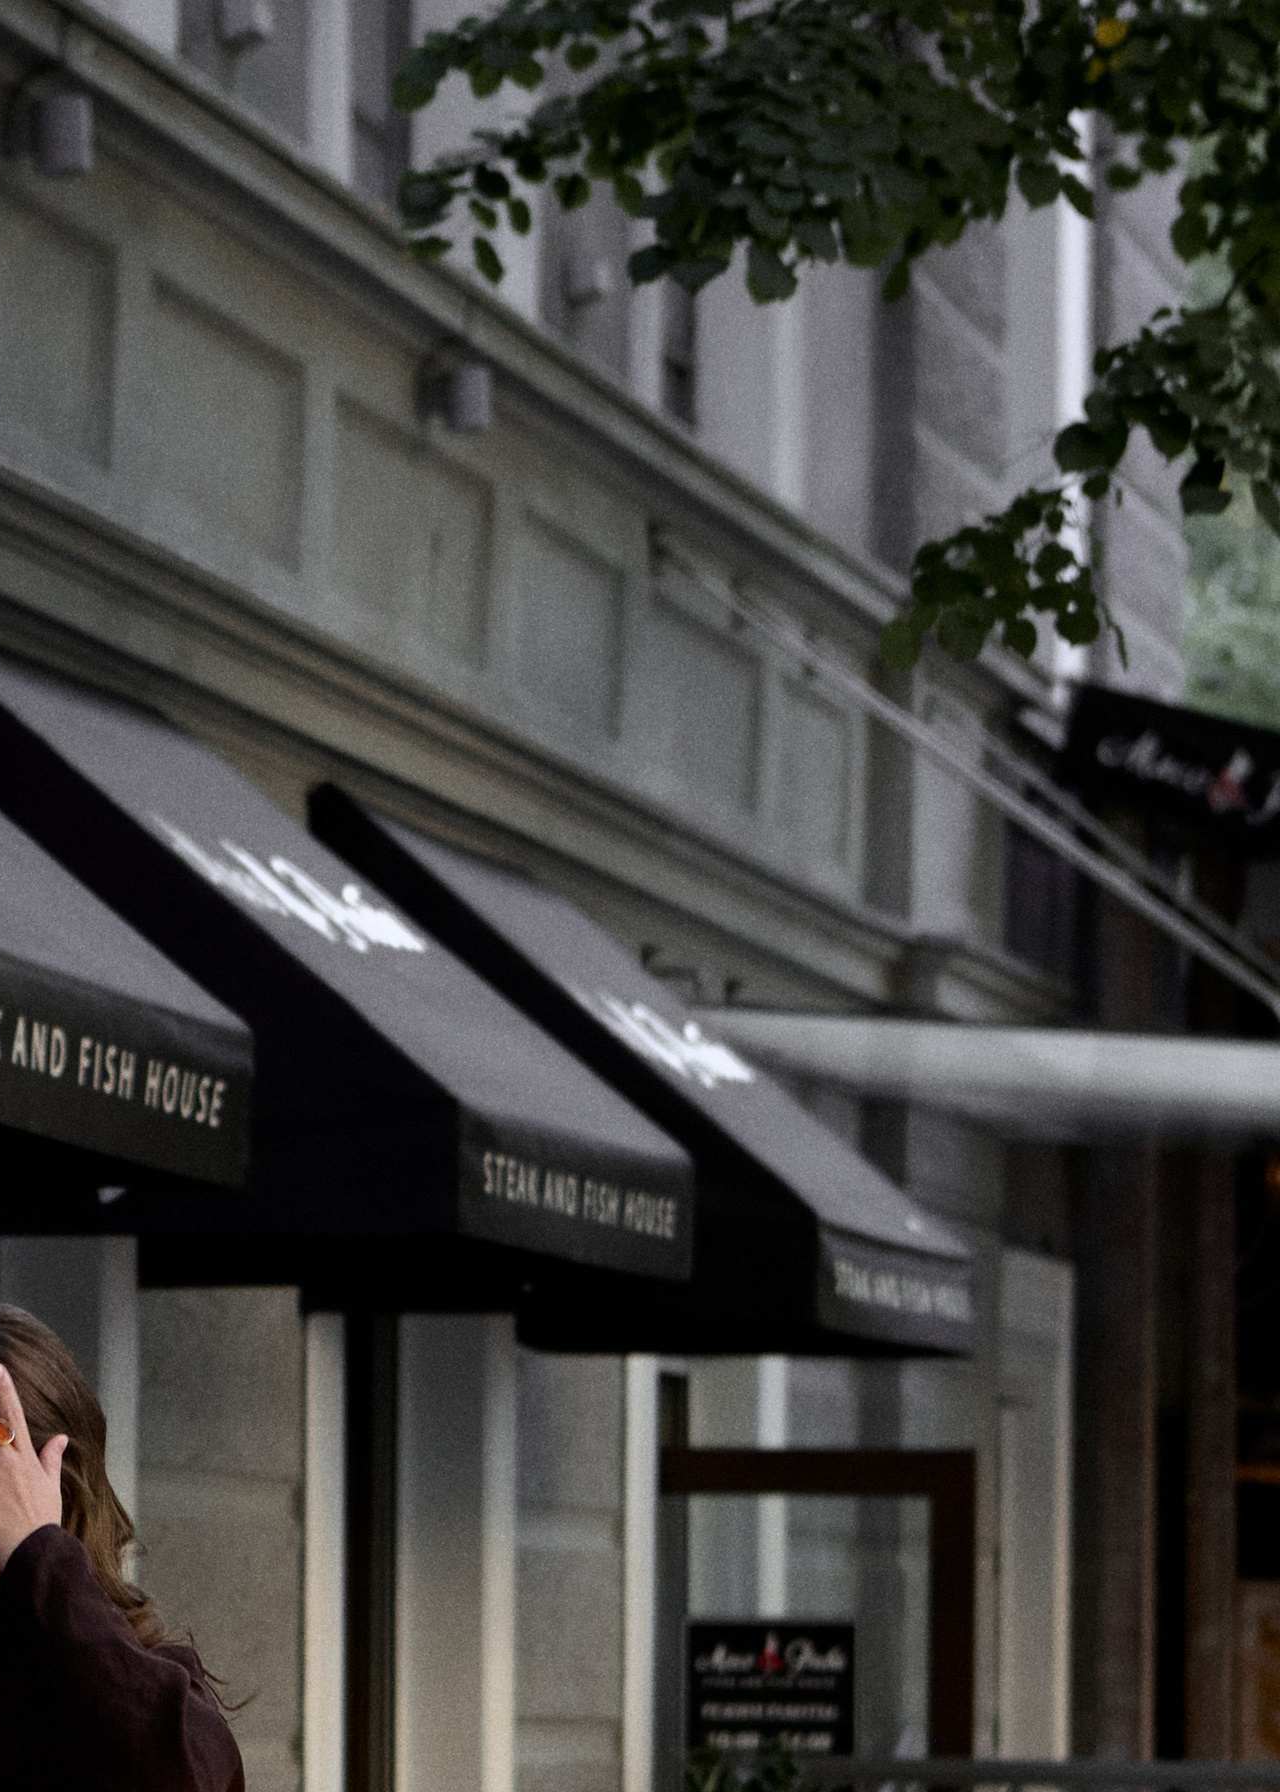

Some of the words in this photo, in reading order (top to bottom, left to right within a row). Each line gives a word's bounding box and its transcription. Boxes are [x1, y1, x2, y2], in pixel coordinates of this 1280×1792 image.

[12, 1015, 67, 1078] AND
[78, 1036, 137, 1100] FISH
[144, 1059, 227, 1127] HOUSE
[484, 1151, 538, 1206] STEAK
